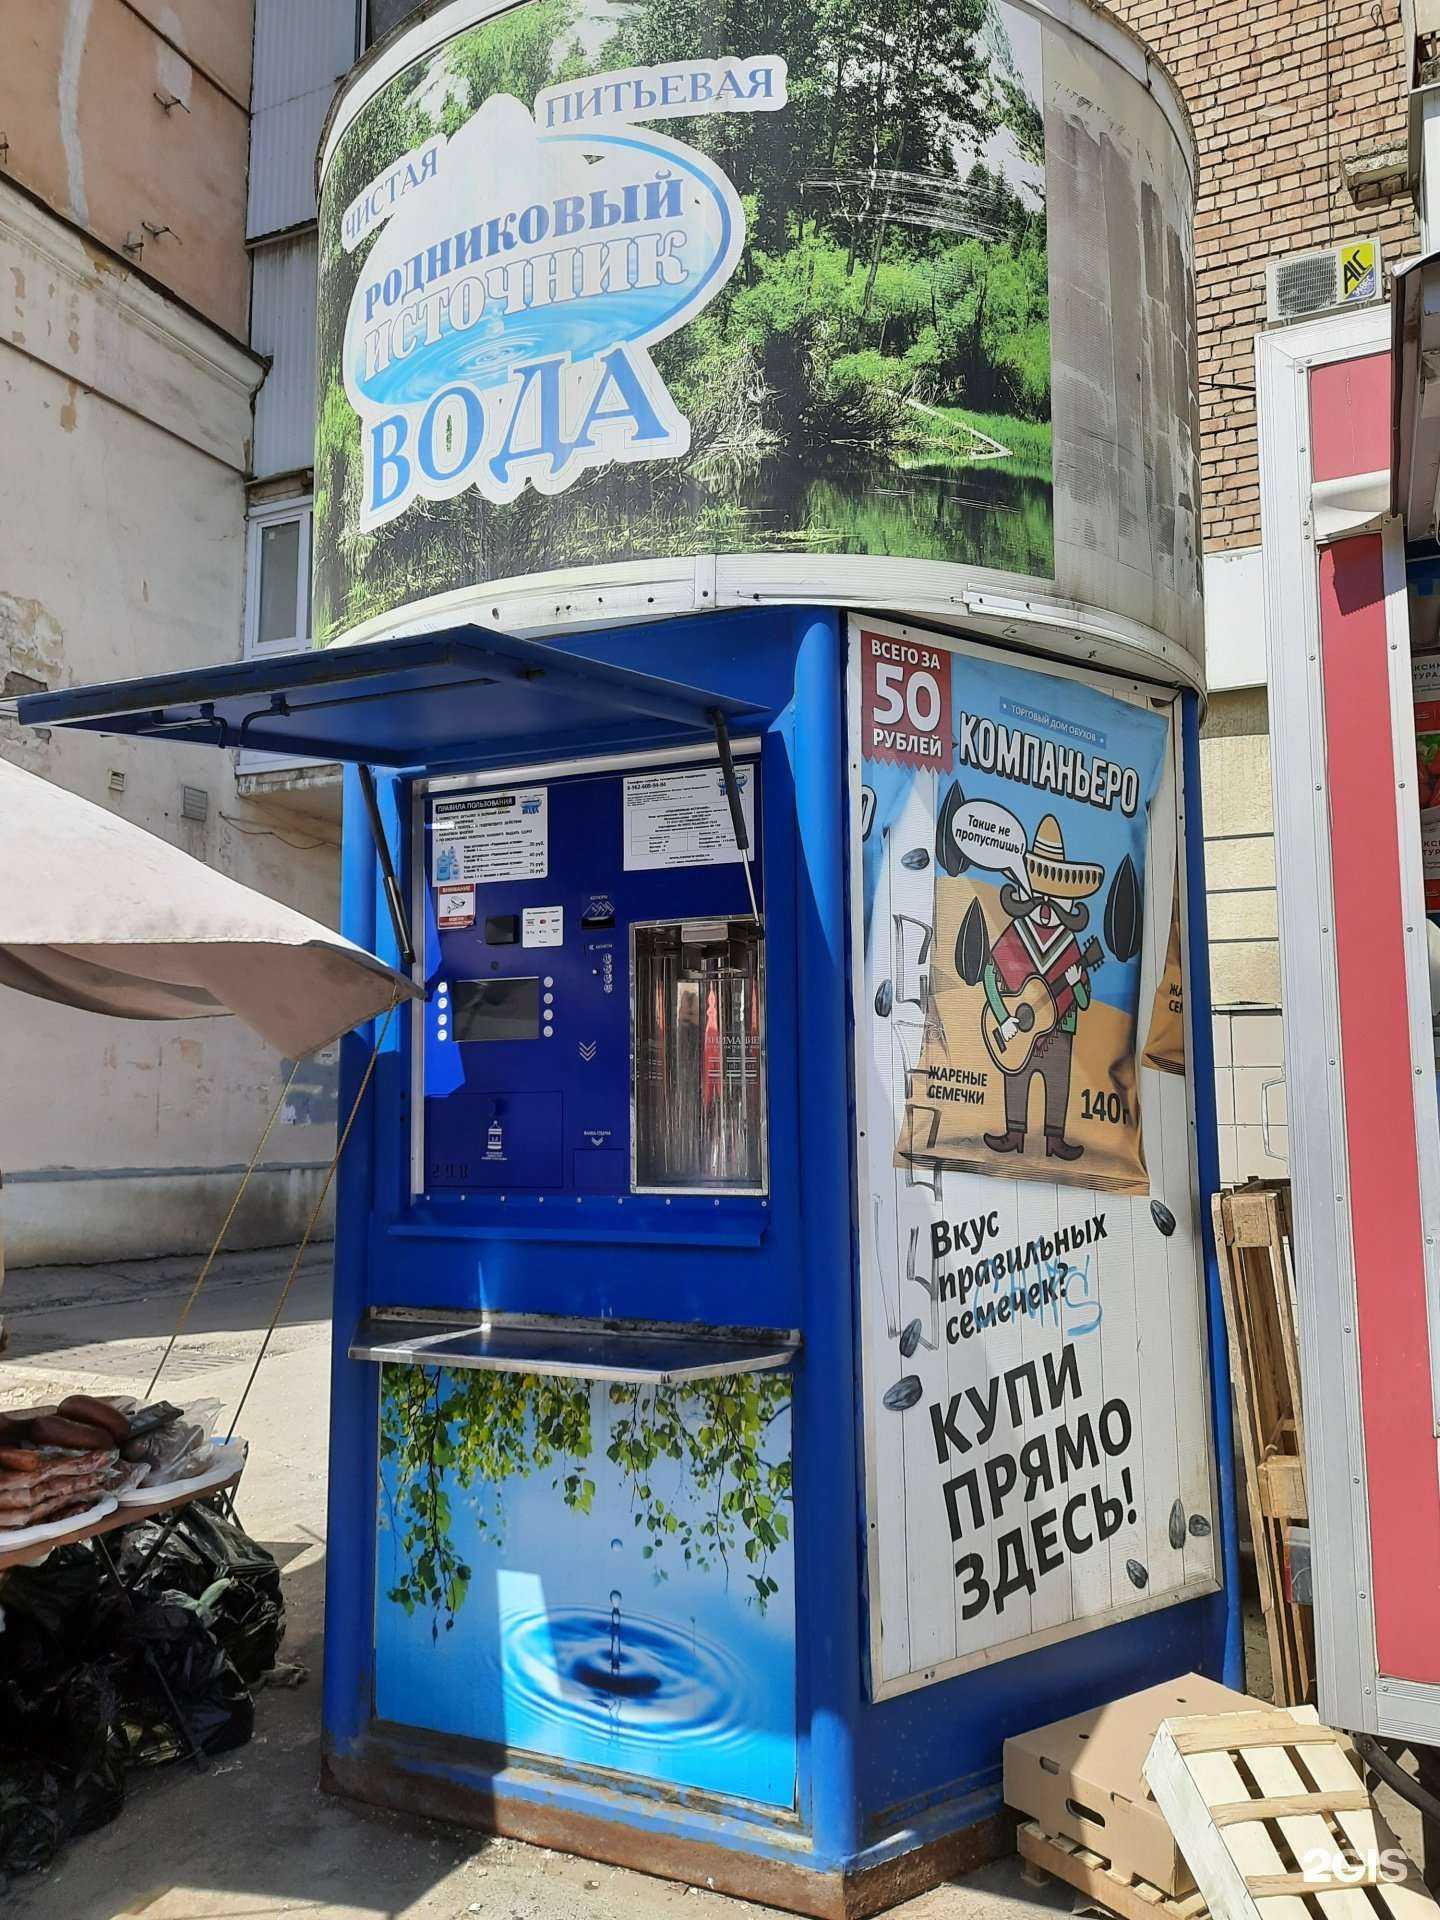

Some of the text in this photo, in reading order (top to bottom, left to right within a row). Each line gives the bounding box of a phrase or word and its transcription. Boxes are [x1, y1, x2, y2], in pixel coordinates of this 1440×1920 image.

[546, 68, 775, 128] ПИТЬЕВАЯ
[345, 147, 439, 238] ЧИСТАЯ
[365, 169, 684, 323] РОДНИКОВЫЙ
[363, 230, 689, 383] ИСТОЧНИК
[369, 348, 670, 512] ВОДА
[871, 639, 941, 670] ВСЕГО ЗА
[873, 663, 941, 732] 50
[1011, 704, 1096, 741] ТОРГОВЫЙ ДОМ ОБУХОВ
[873, 727, 943, 758] РУБЛЕЙ
[960, 712, 1139, 817] КОМПАНЬЕРО
[955, 828, 1025, 856] пропустишь!
[968, 814, 1011, 837] Такие не
[927, 1065, 988, 1087] ЖАРЕНЫЕ
[927, 1085, 985, 1105] СЕМЕЧКИ
[931, 1210, 999, 1259] Вкус
[938, 1213, 1108, 1302] правильных
[946, 1262, 1069, 1345] семечек?
[929, 1343, 1084, 1464] КУПИ
[943, 1398, 1132, 1542] ПРЯМО
[956, 1467, 1138, 1621] ЗДЕСЬ!
